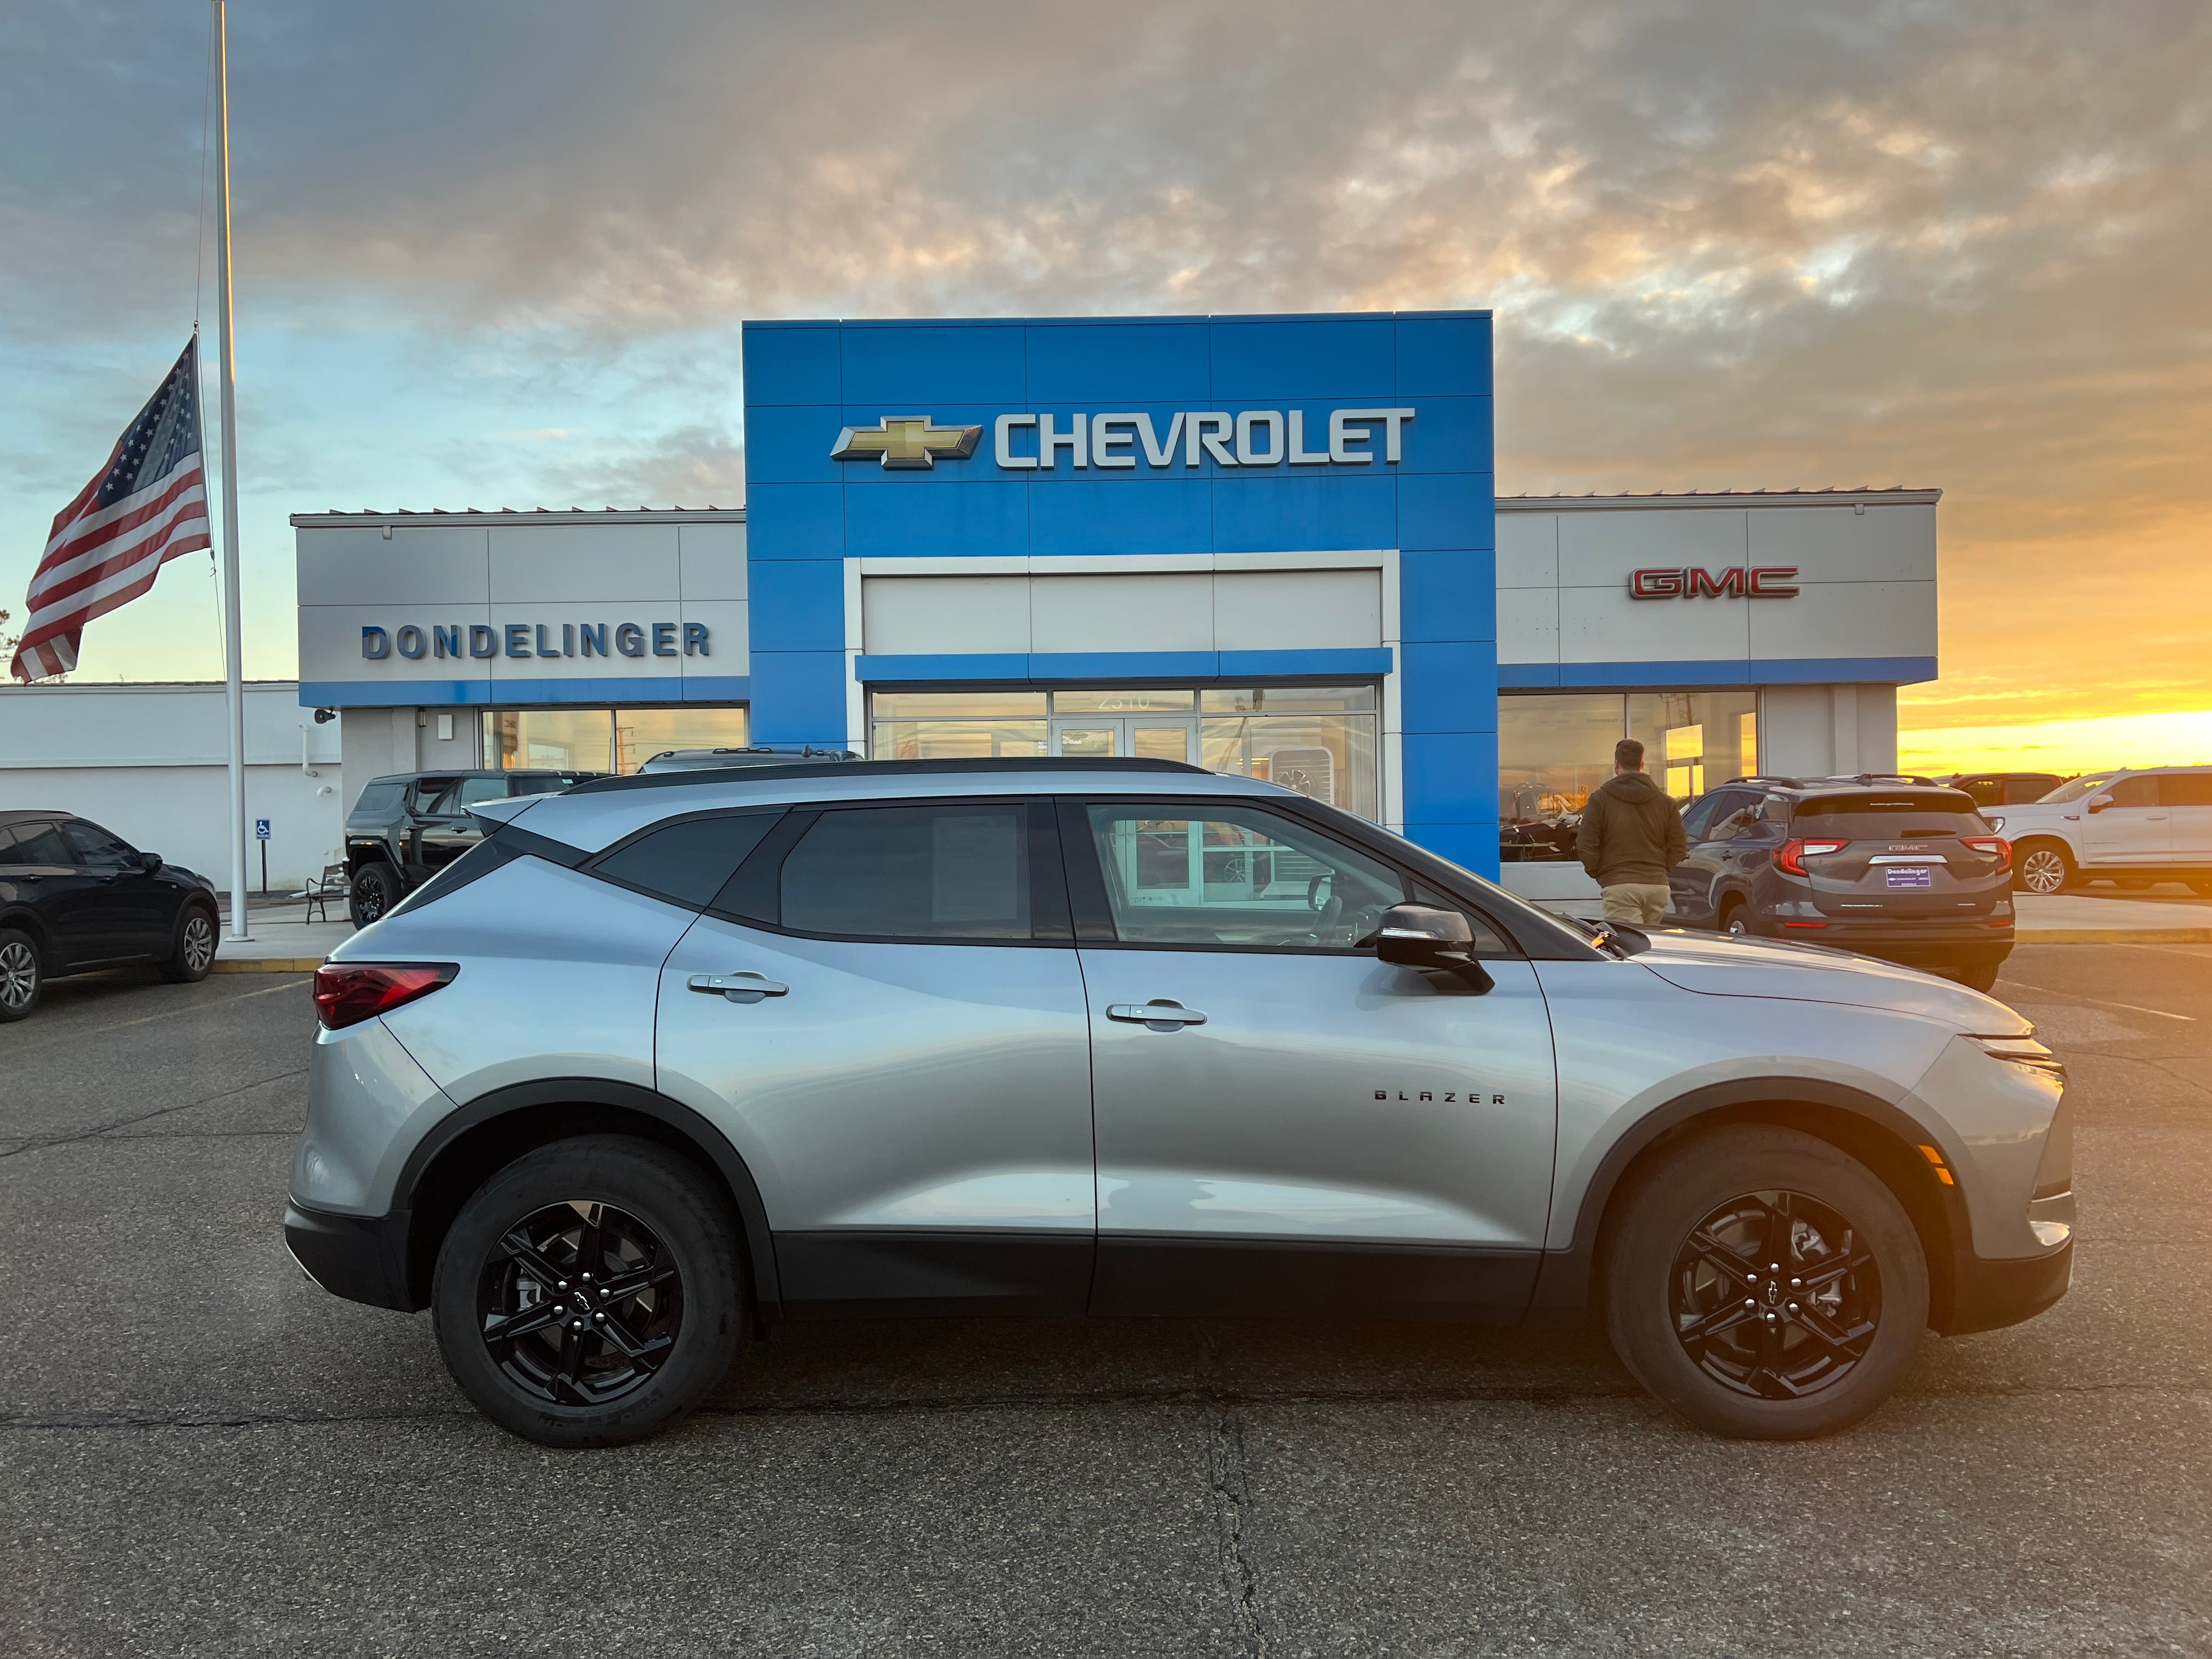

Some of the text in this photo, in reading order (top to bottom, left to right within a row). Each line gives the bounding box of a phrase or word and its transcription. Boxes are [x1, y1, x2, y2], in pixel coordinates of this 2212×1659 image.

[995, 408, 1415, 469] CHEVROLET
[1629, 566, 1800, 600] GMC
[362, 622, 709, 659] DONDELINGER
[1374, 1090, 1505, 1105] BLAZER
